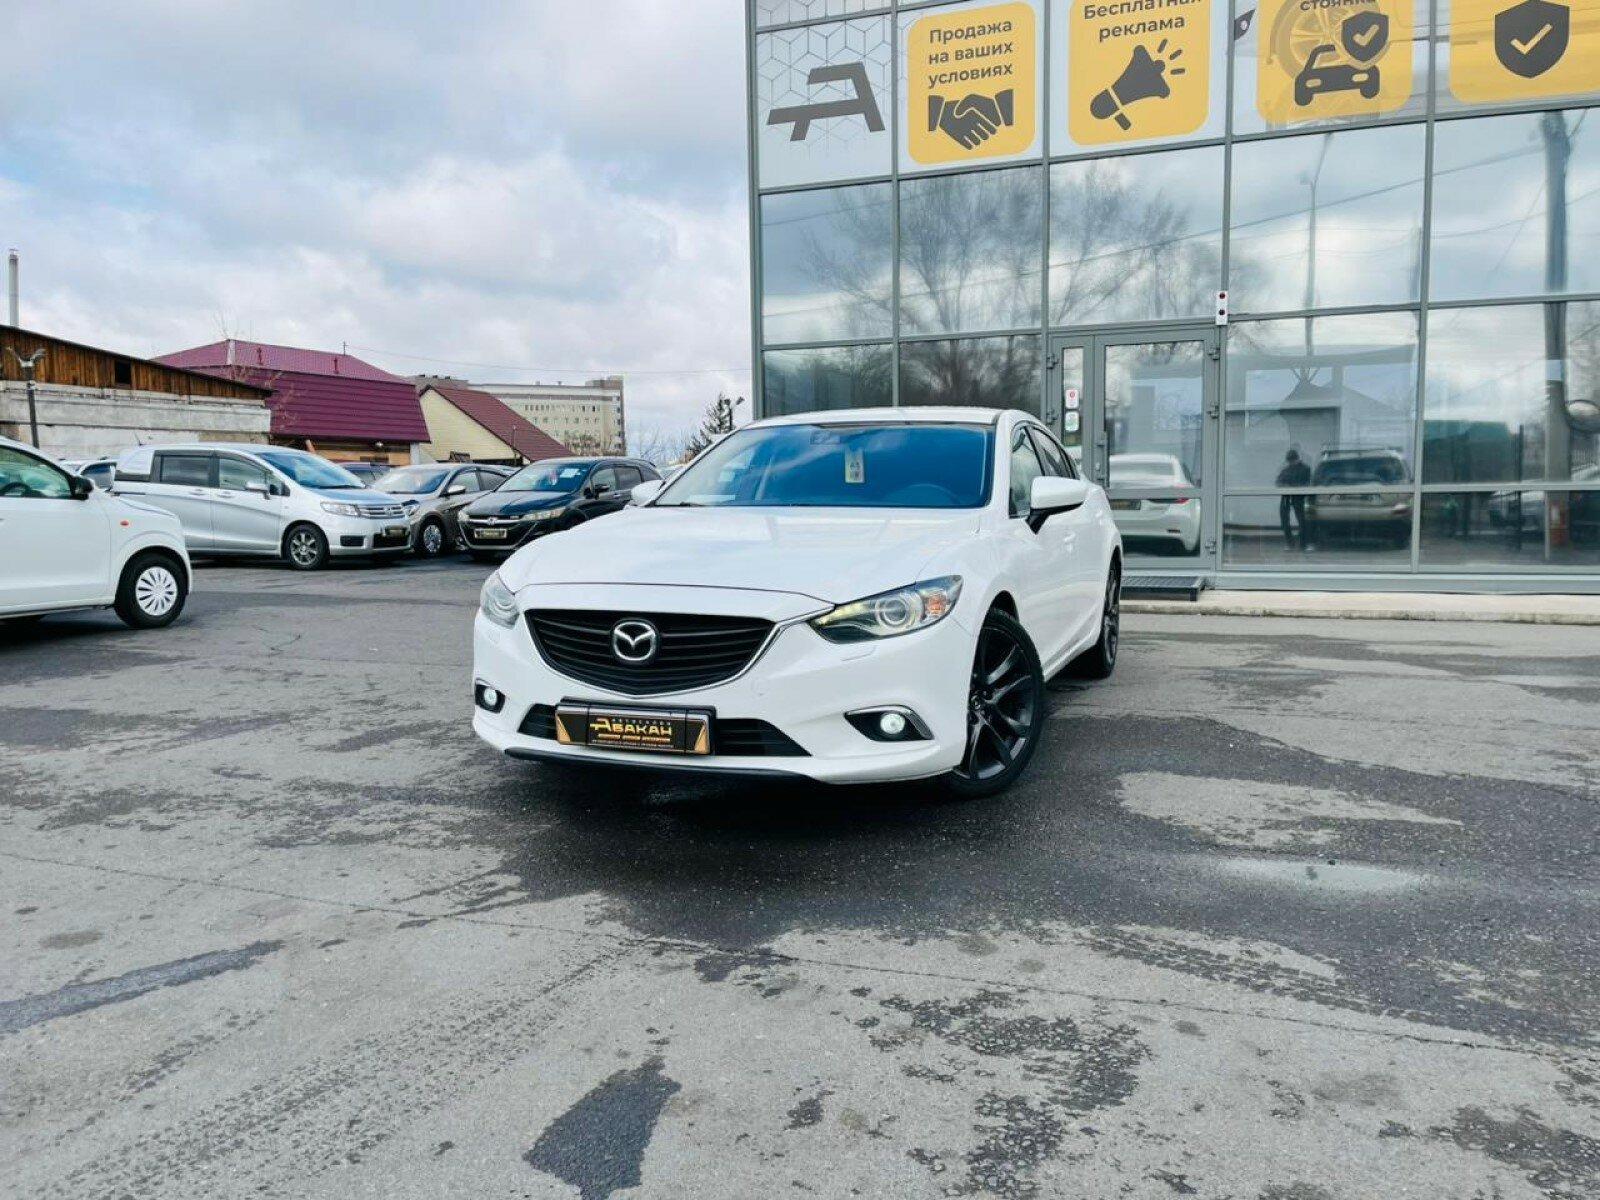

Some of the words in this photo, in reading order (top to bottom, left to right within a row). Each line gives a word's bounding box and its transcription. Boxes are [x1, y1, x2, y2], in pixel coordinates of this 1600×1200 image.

[1084, 0, 1201, 20] Бесплатн
[929, 20, 1012, 45] Продажа
[1098, 16, 1186, 43] реклама
[928, 51, 950, 66] на
[954, 41, 1014, 61] ваших
[928, 63, 1014, 90] условиях
